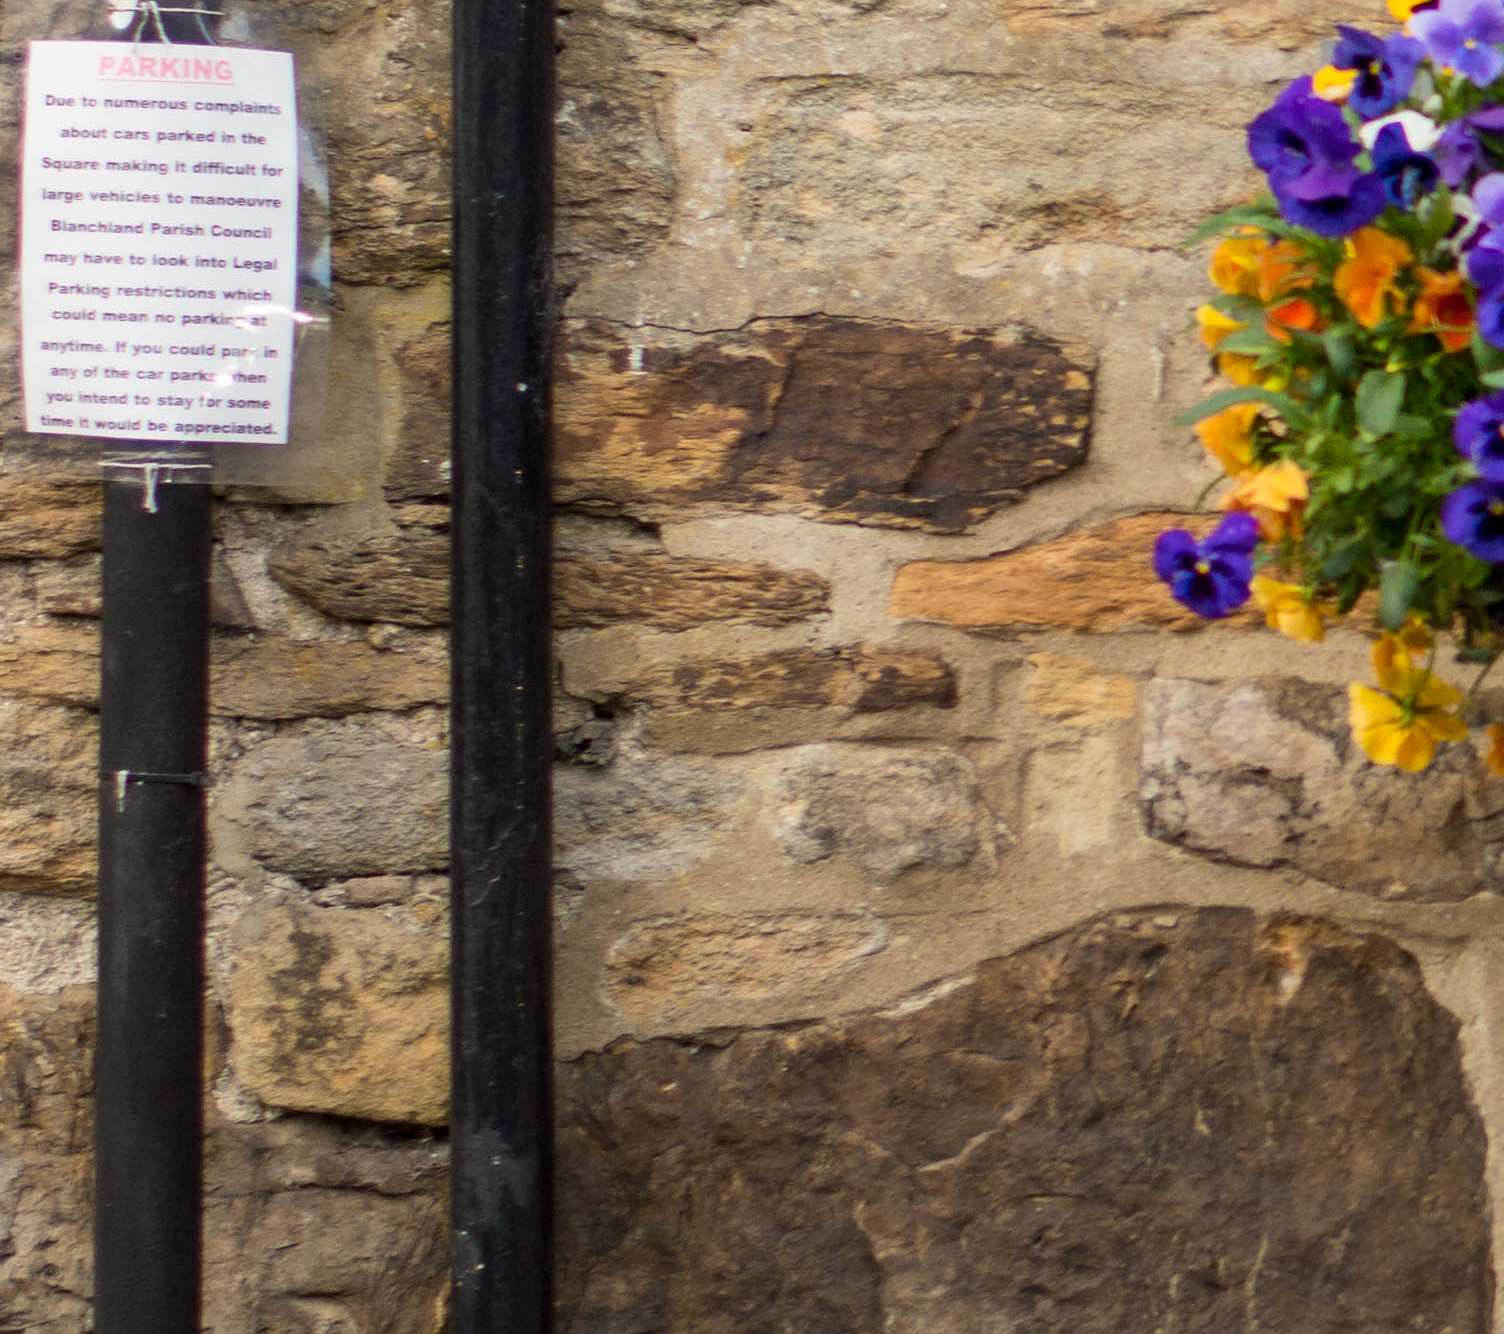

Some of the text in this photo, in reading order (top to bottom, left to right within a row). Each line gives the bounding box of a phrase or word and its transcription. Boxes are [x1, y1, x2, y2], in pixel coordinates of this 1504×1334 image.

[98, 55, 234, 81] PARKING
[44, 95, 282, 115] Due to numerous complaints
[60, 127, 266, 145] about cars parked in the
[42, 157, 284, 177] Square making it difficult for
[42, 189, 282, 209] large vehicles to manoeuvre
[50, 219, 272, 239] Blanchland Parish Council
[44, 252, 278, 272] may have to look into Legal
[48, 283, 272, 301] Parking restrictions which
[52, 309, 96, 321] could
[102, 312, 148, 322] mean
[155, 313, 175, 323] no
[250, 315, 268, 327] at
[40, 340, 278, 359] anytime. If you could par in
[50, 367, 76, 379] any
[84, 366, 100, 378] of
[104, 367, 129, 379] the
[136, 369, 164, 379] car
[221, 371, 267, 383] hen
[46, 391, 73, 404] you
[79, 391, 128, 404] intend
[134, 393, 150, 405] to
[158, 395, 192, 409] stay
[226, 399, 271, 409] some
[40, 415, 278, 435] time it would be appreciated.
